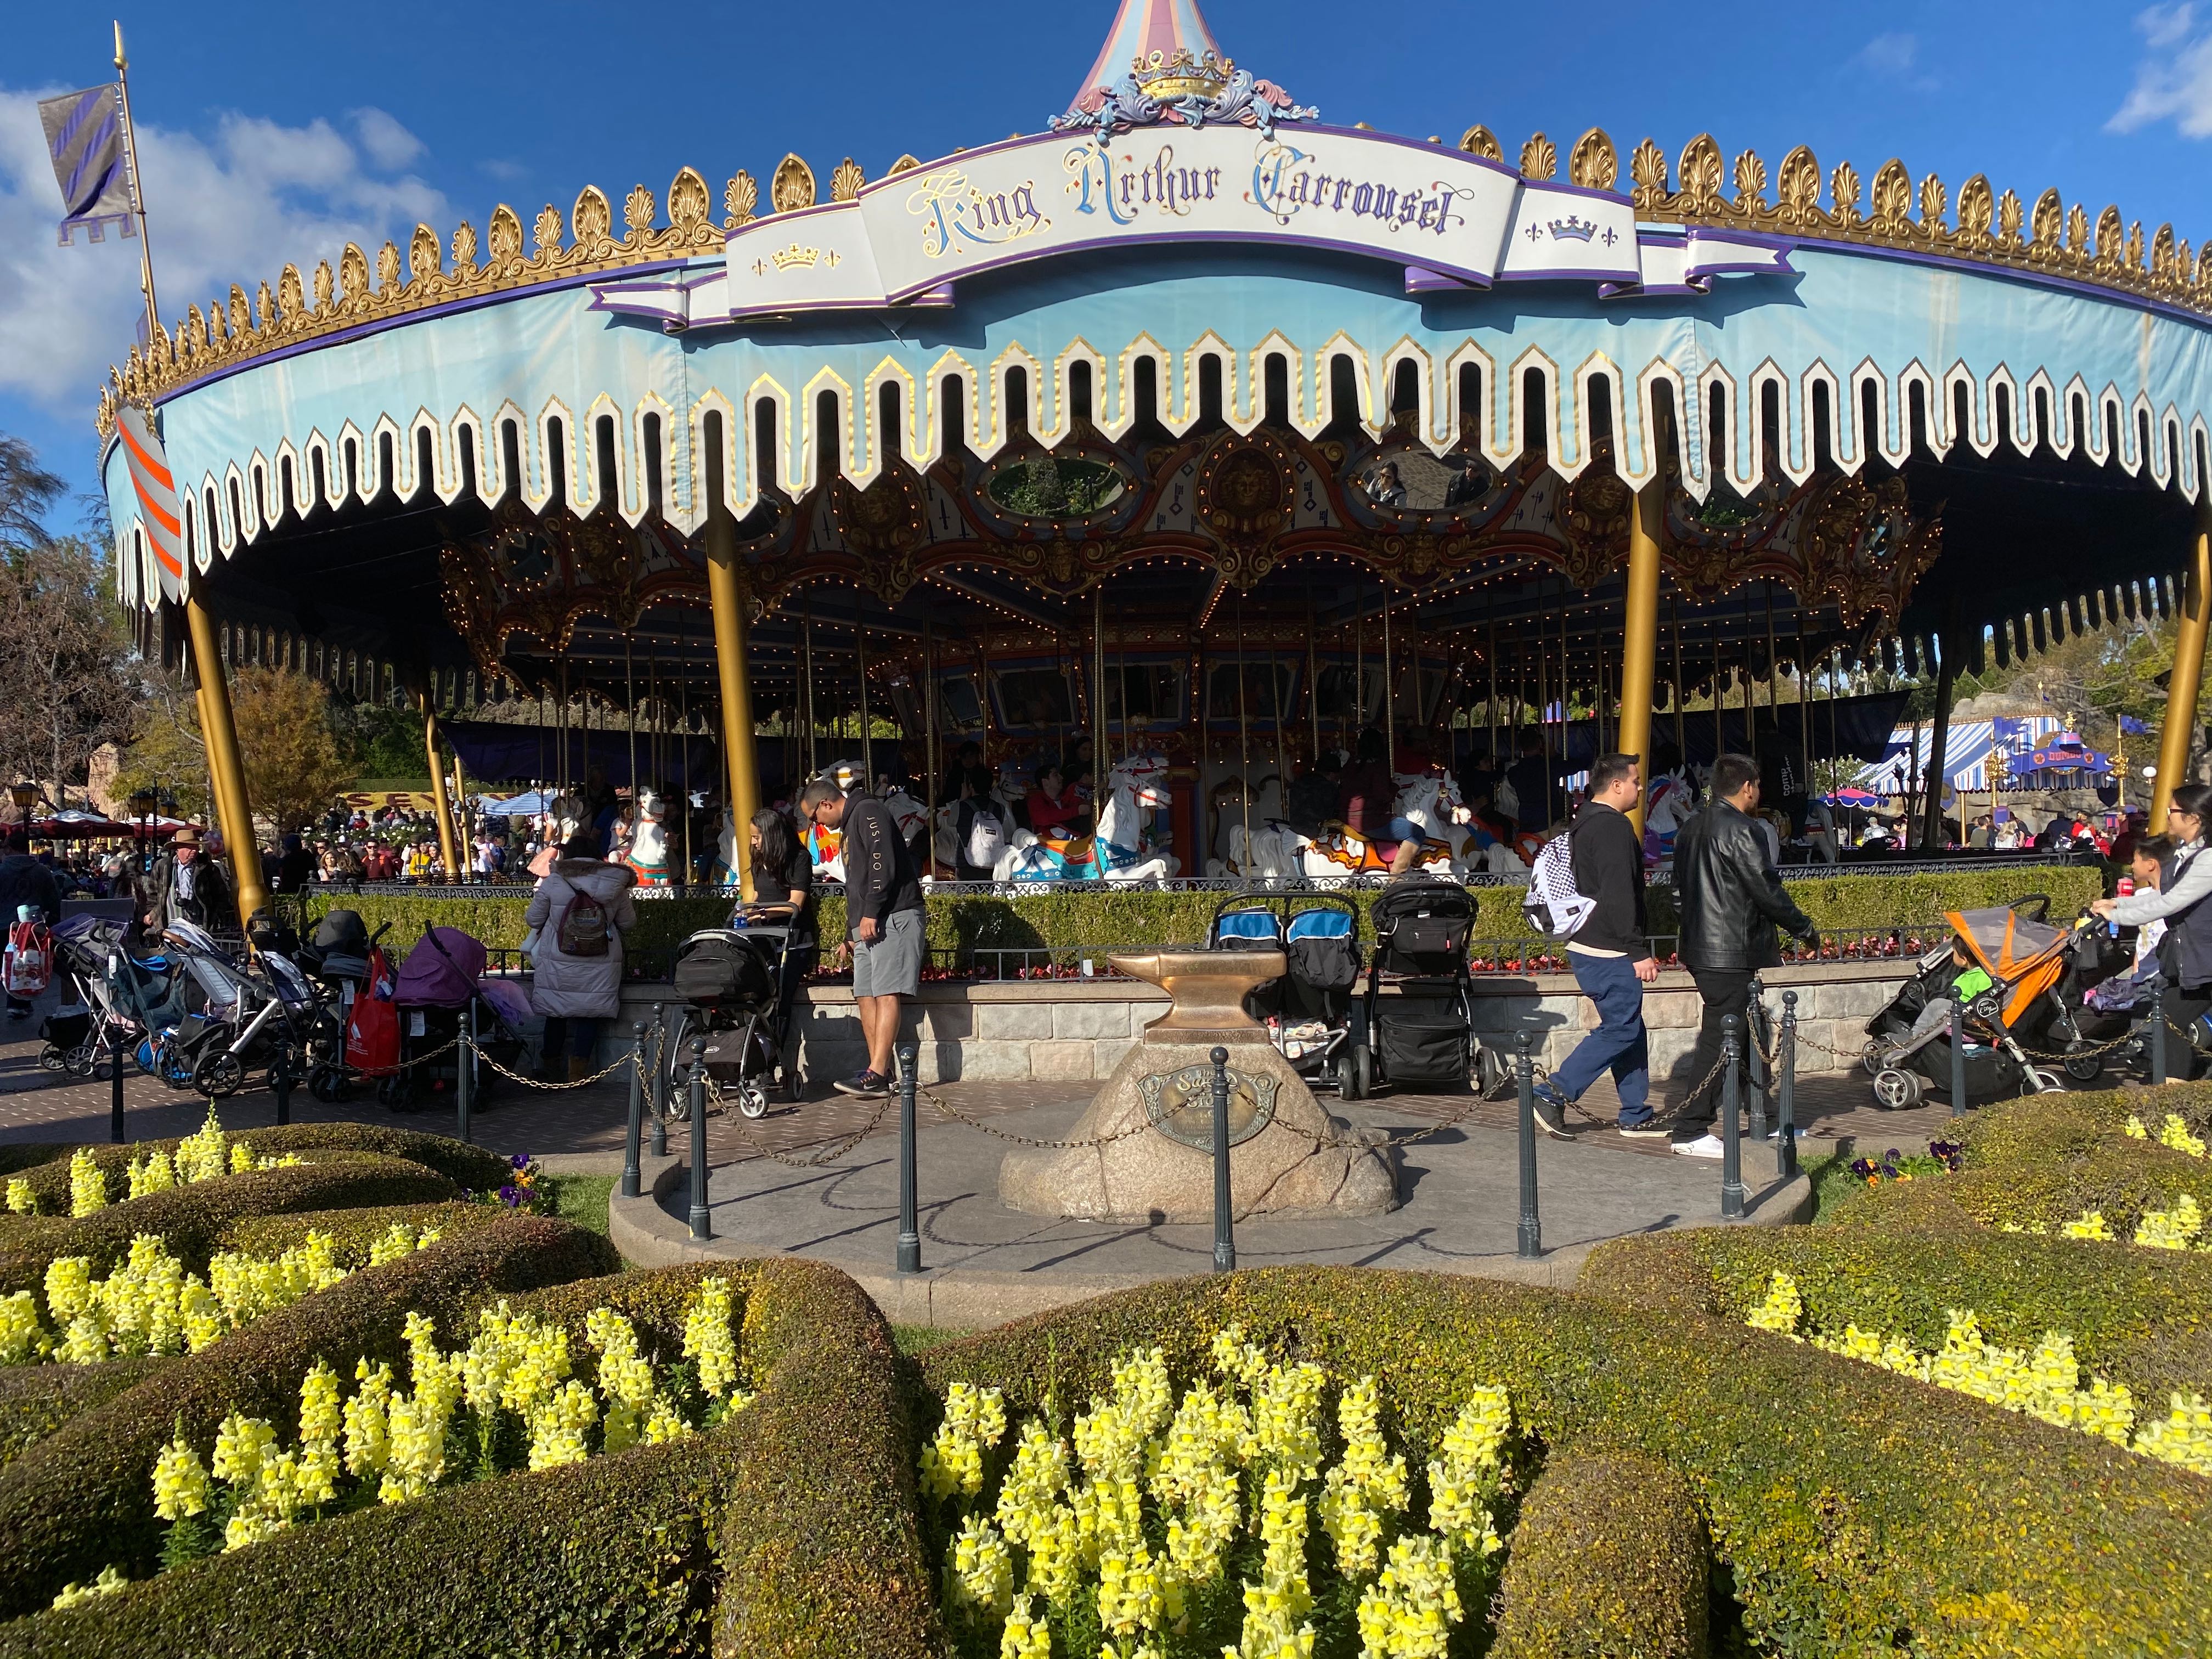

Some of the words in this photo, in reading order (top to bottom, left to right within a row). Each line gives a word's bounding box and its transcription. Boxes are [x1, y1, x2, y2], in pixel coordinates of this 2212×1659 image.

[906, 168, 1052, 258] King
[1062, 142, 1221, 225] Arthur
[1242, 139, 1474, 235] Carrousel
[873, 853, 882, 870] DO
[873, 879, 881, 890] IT
